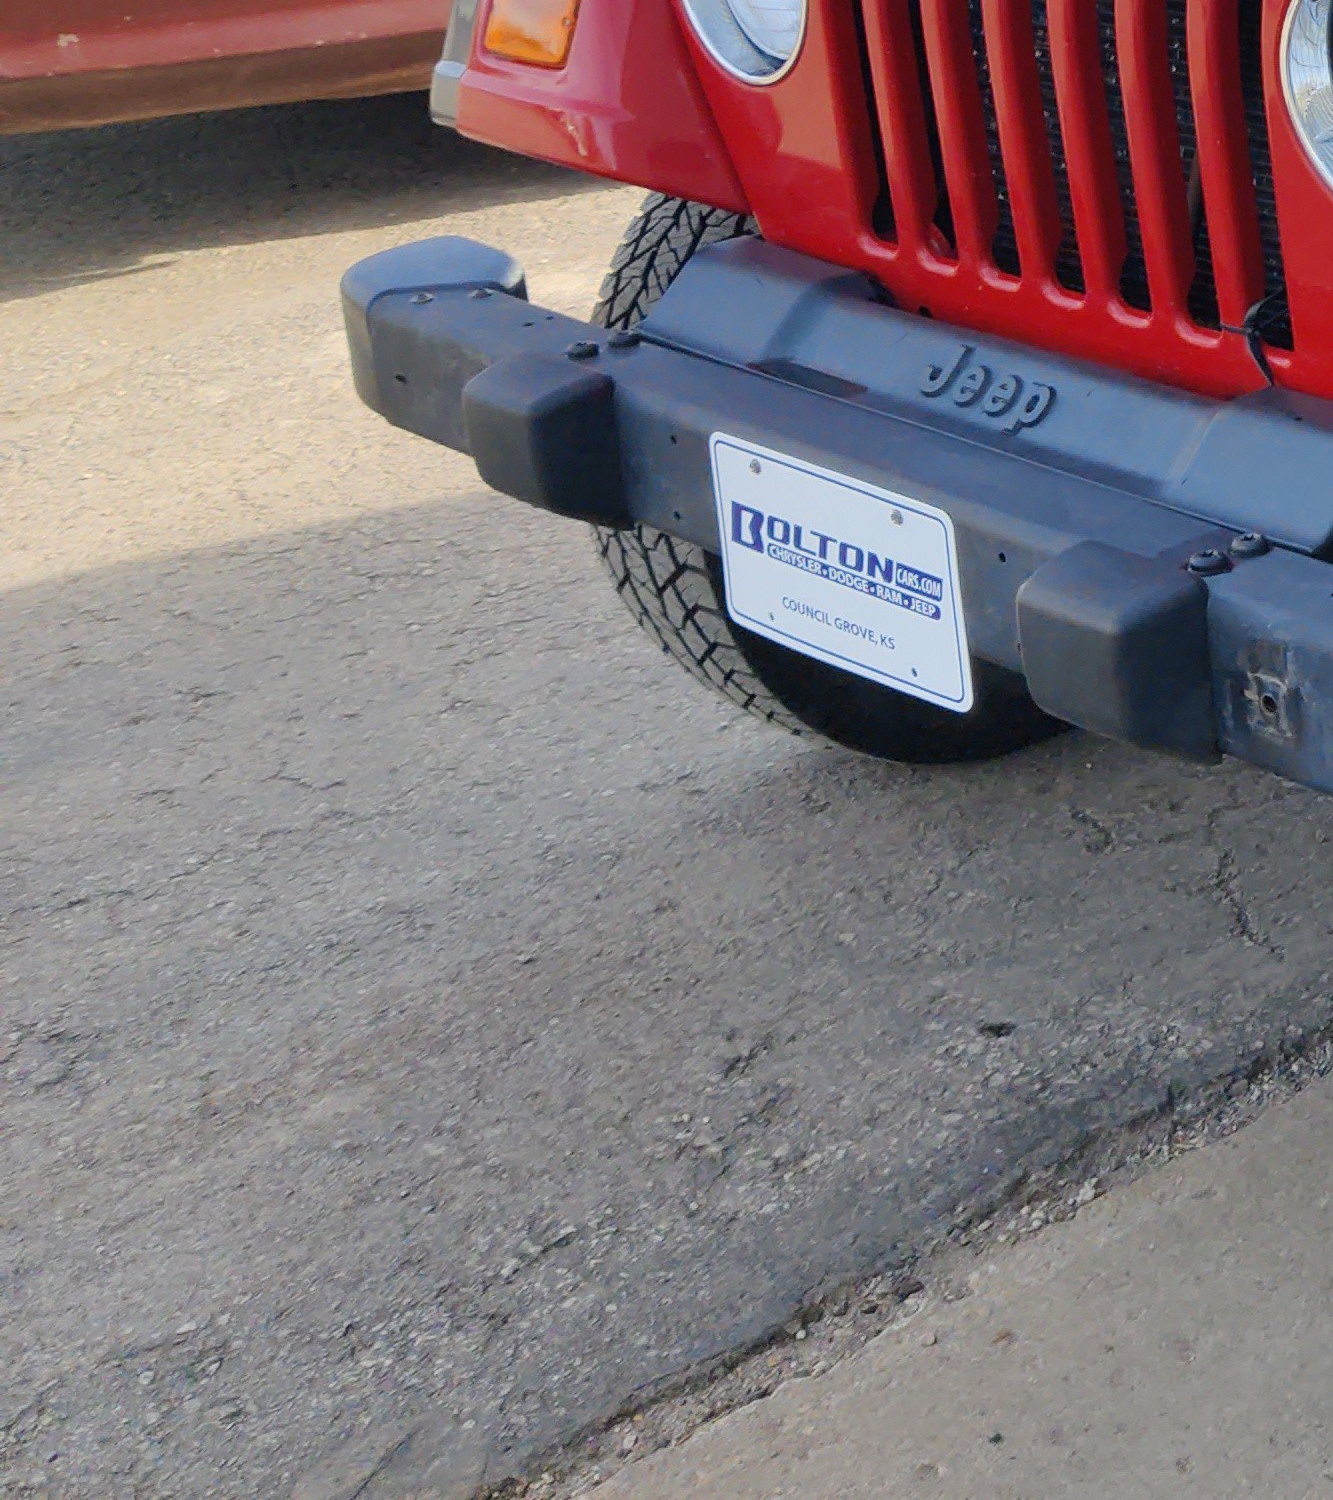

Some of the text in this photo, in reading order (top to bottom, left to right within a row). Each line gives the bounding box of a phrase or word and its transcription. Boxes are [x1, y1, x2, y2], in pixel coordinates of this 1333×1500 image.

[920, 344, 1057, 436] Jeep
[731, 500, 942, 598] BOLTON CARS.COM
[768, 544, 936, 617] CHRYSLER DODGE RAM JEEP
[782, 596, 895, 650] COUNCIL GROVE, KS
